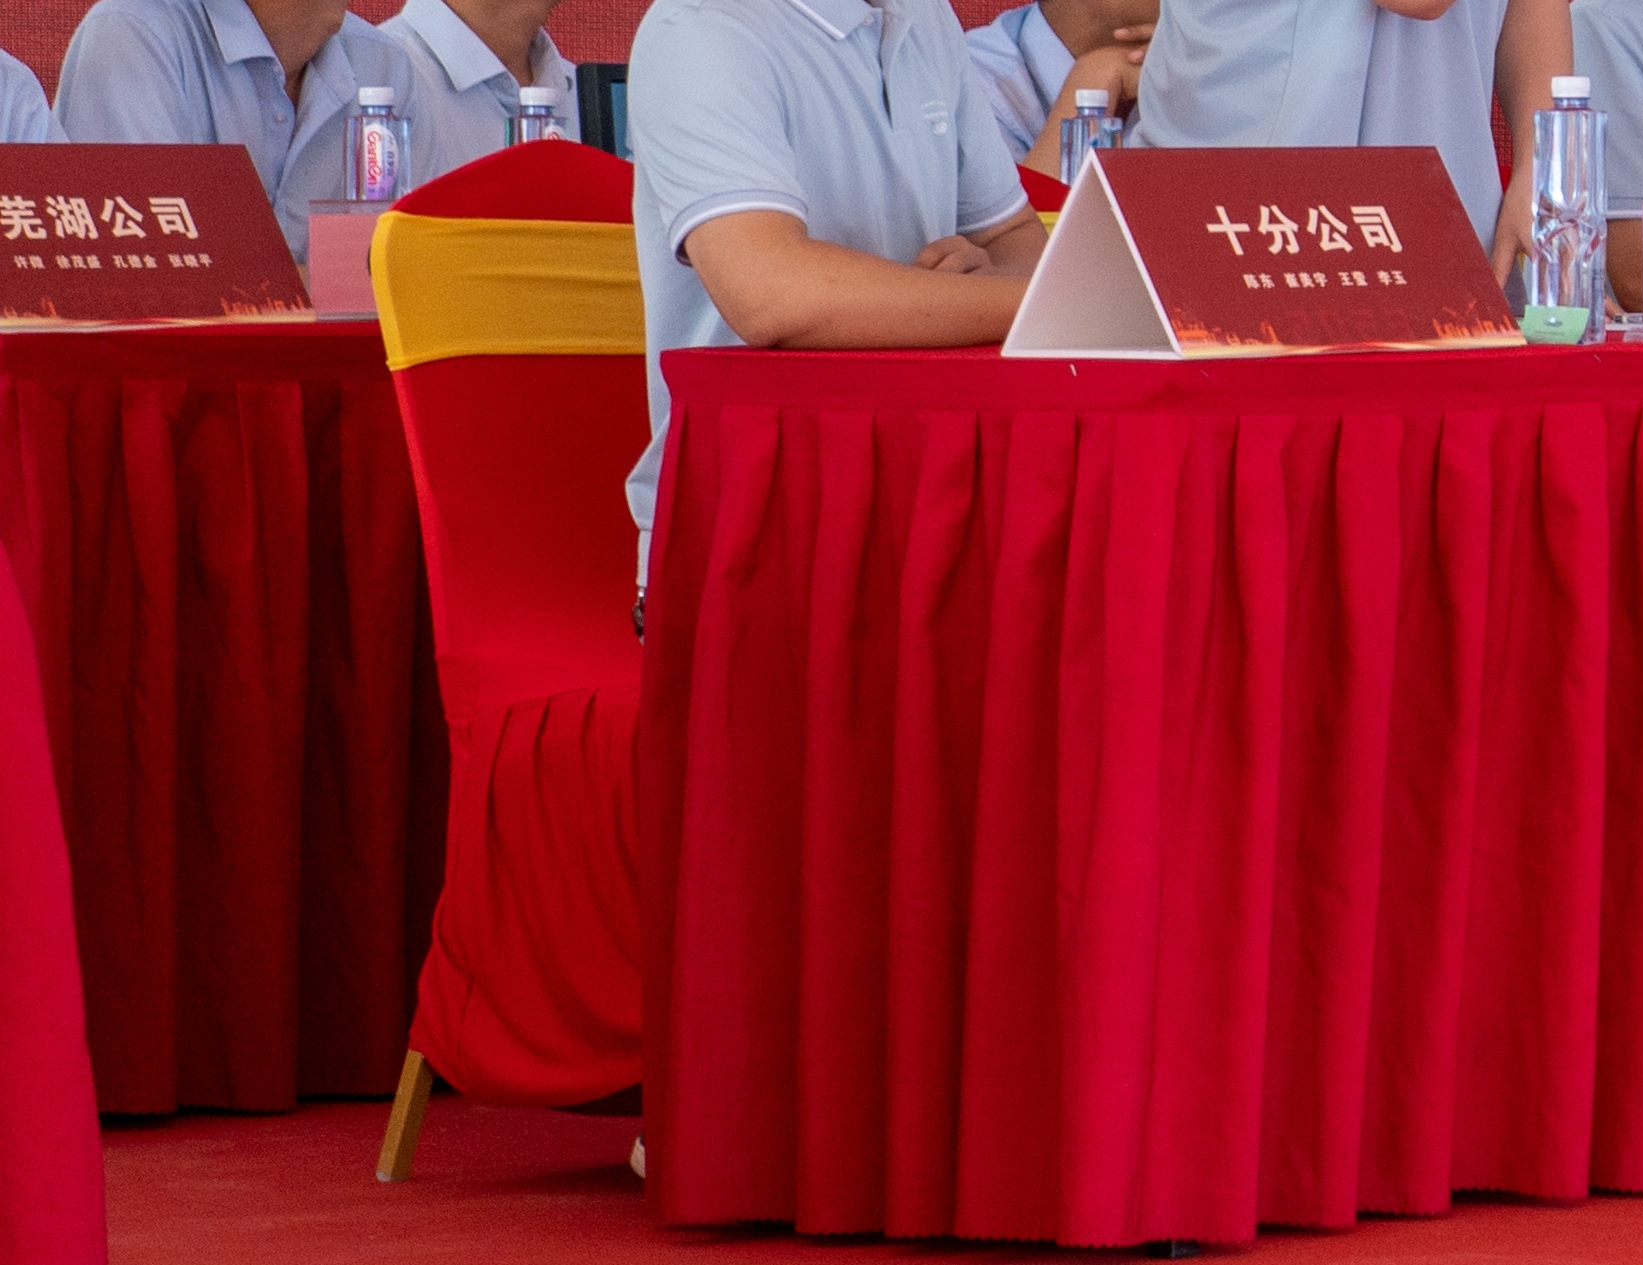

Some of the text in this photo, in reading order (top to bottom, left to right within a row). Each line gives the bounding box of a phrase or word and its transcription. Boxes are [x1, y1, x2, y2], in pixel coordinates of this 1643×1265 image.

[0, 195, 199, 240] 芜湖公司
[1206, 204, 1403, 256] 十分公司
